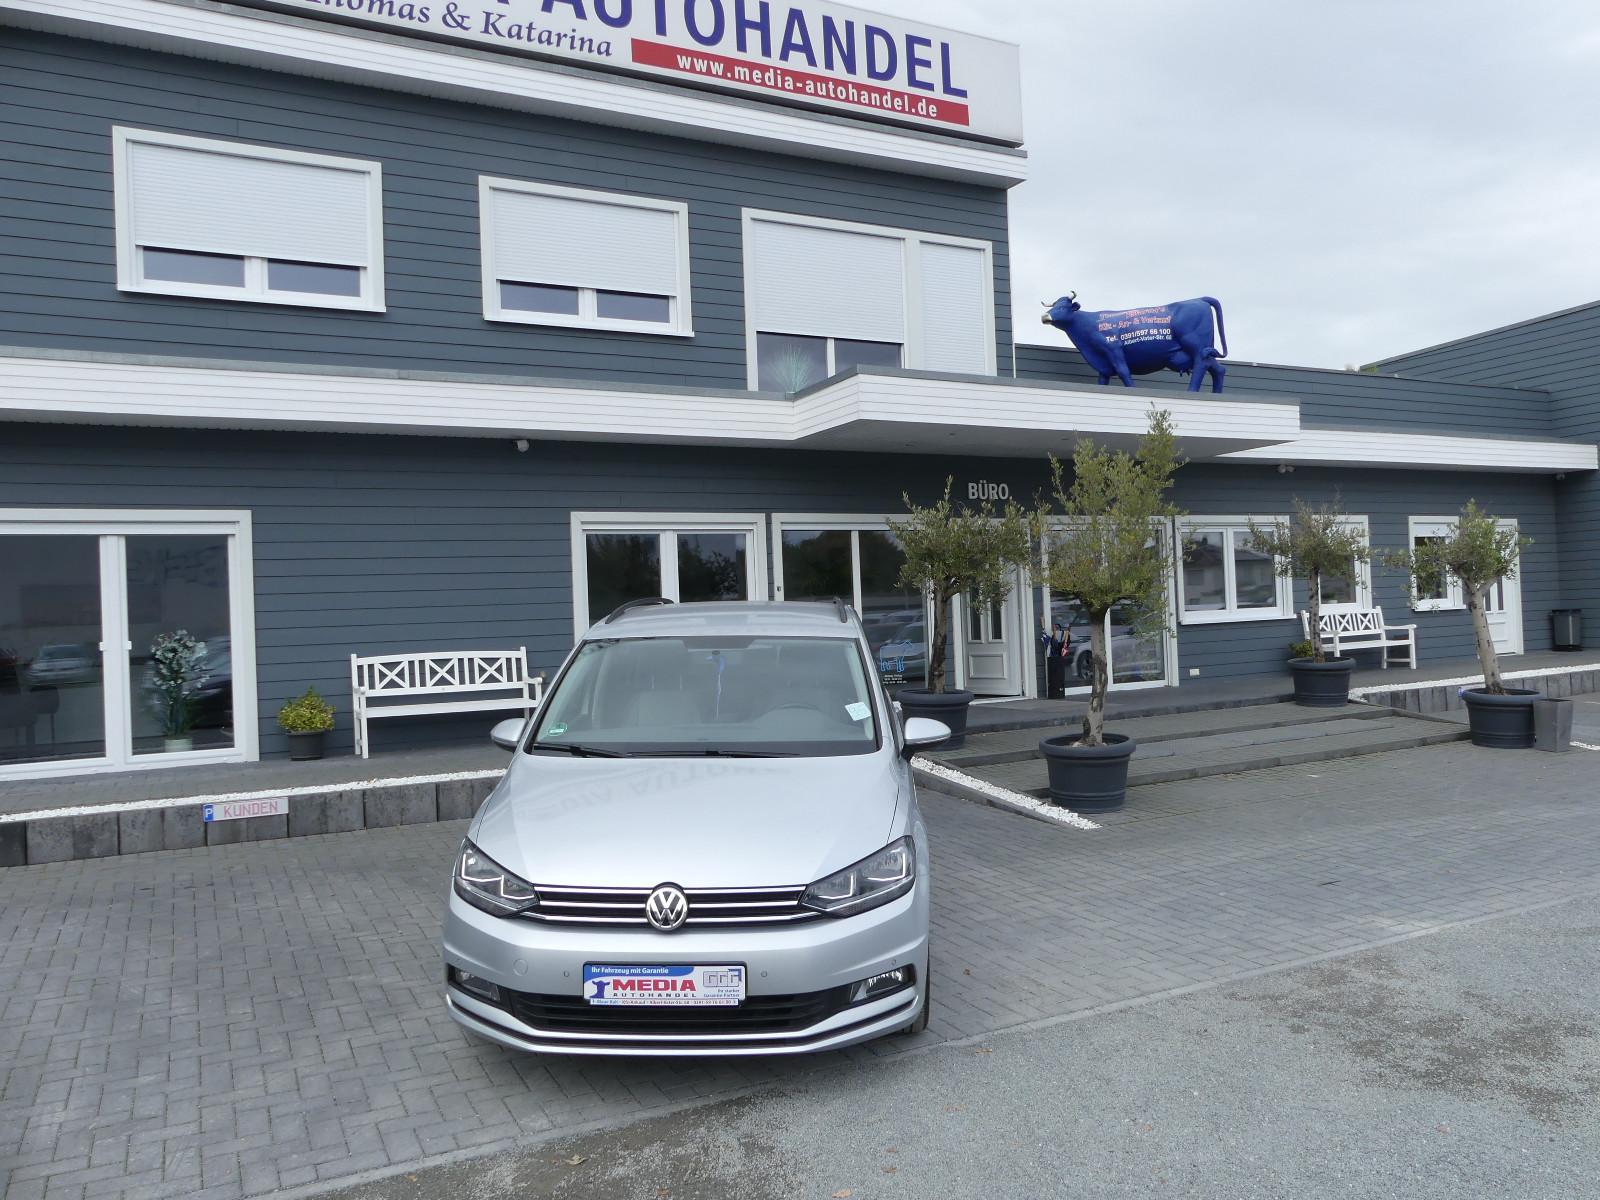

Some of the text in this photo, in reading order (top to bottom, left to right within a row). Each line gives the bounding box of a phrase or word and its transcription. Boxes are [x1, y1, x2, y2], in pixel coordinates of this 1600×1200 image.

[306, 0, 613, 57] omas & Katarina
[677, 53, 938, 118] www.media-autohandel.de
[968, 480, 1009, 500] BÜRO
[223, 801, 278, 818] KUNDEN
[602, 967, 630, 975] Fahrzeug
[613, 979, 696, 991] MEDIA
